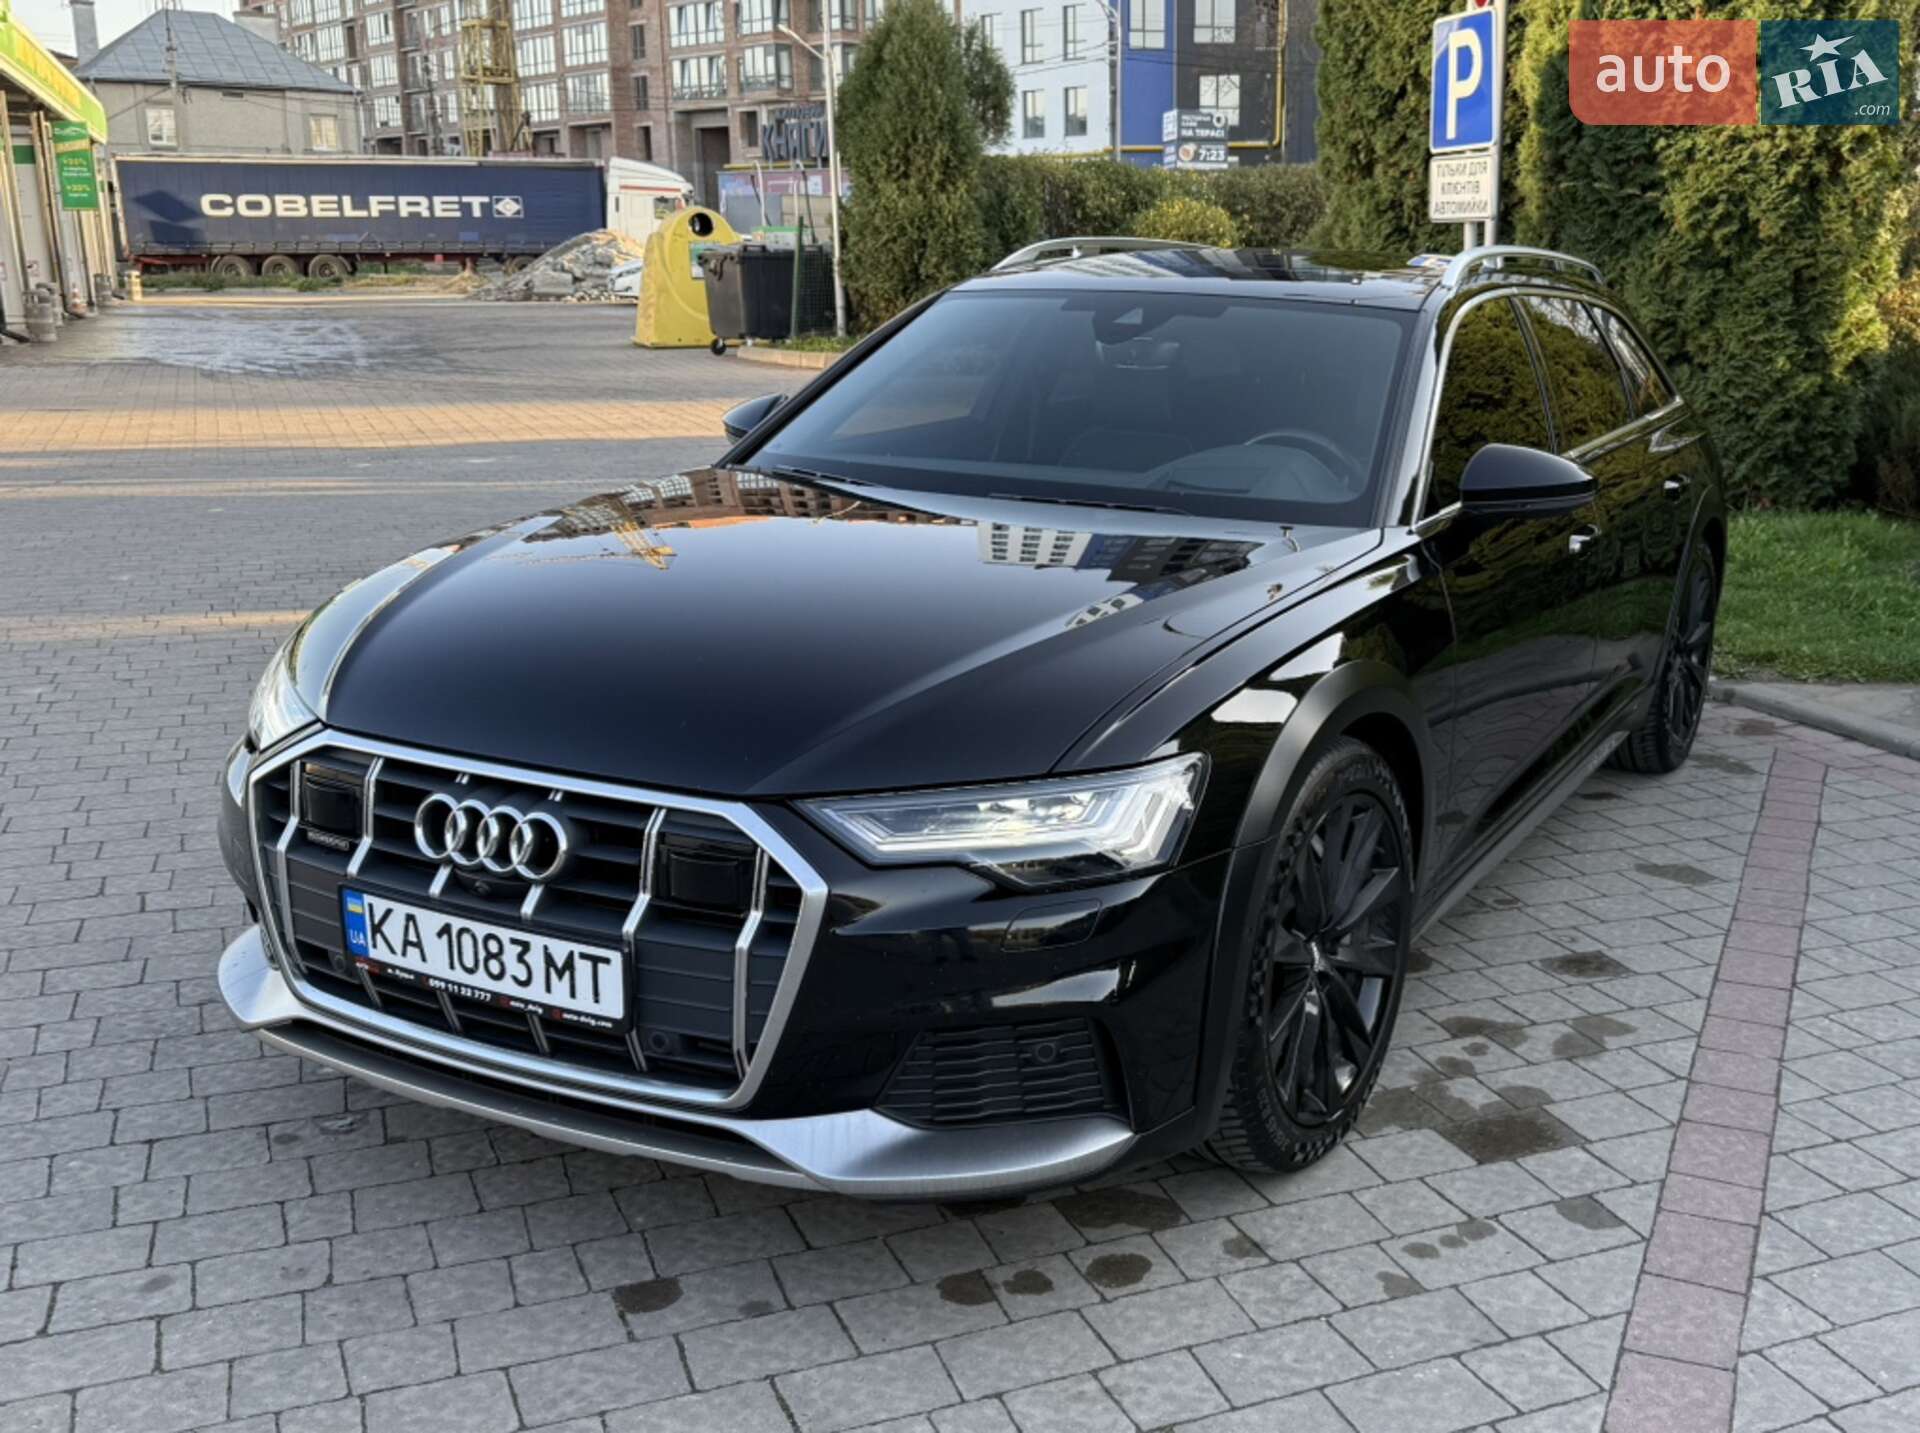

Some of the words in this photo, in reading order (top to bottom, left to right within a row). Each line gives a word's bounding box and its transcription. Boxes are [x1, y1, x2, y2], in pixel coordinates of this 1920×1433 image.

[1446, 28, 1483, 140] P
[1436, 162, 1467, 178] ТІЛЬКИ
[1468, 160, 1488, 177] ДЛЯ
[200, 193, 490, 218] COBELFRET
[350, 930, 367, 947] UA
[367, 902, 427, 963] KA
[436, 922, 533, 988] 1083
[543, 943, 612, 1004] MT
